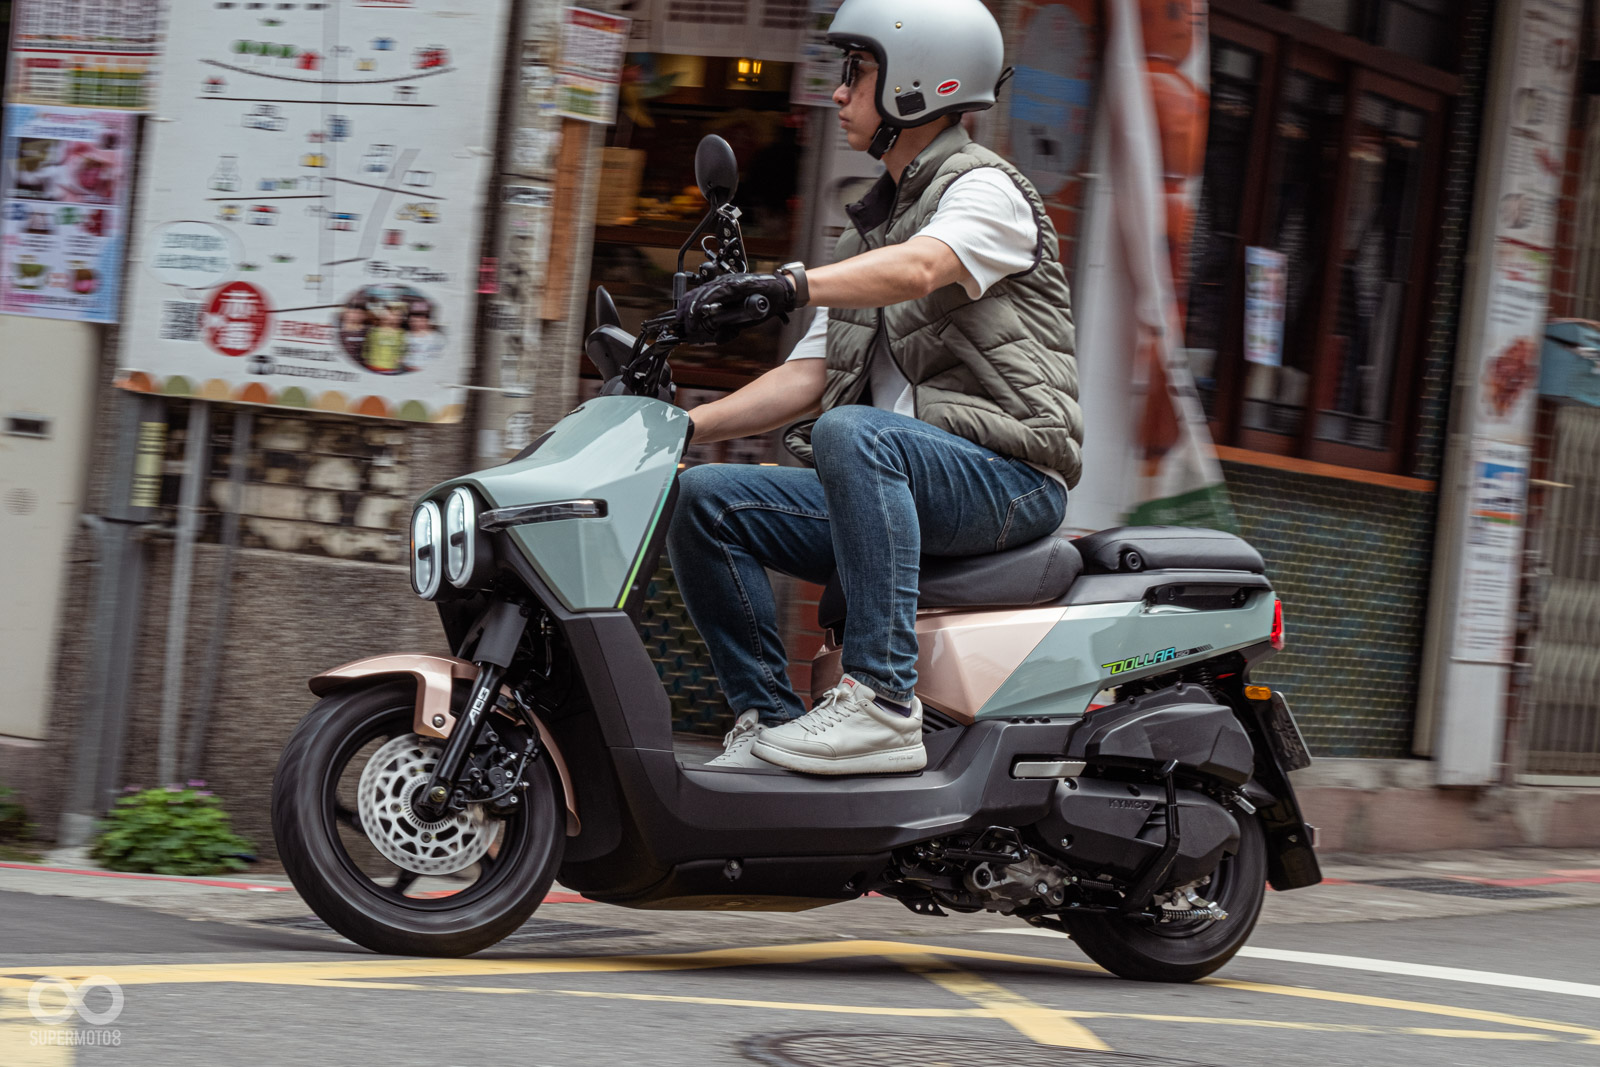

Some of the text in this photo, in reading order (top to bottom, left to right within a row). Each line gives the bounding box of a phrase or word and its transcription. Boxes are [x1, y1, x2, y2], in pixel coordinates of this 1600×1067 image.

[1102, 647, 1176, 675] DOLLAR
[469, 687, 490, 726] ABS
[1109, 799, 1151, 811] KYMCO
